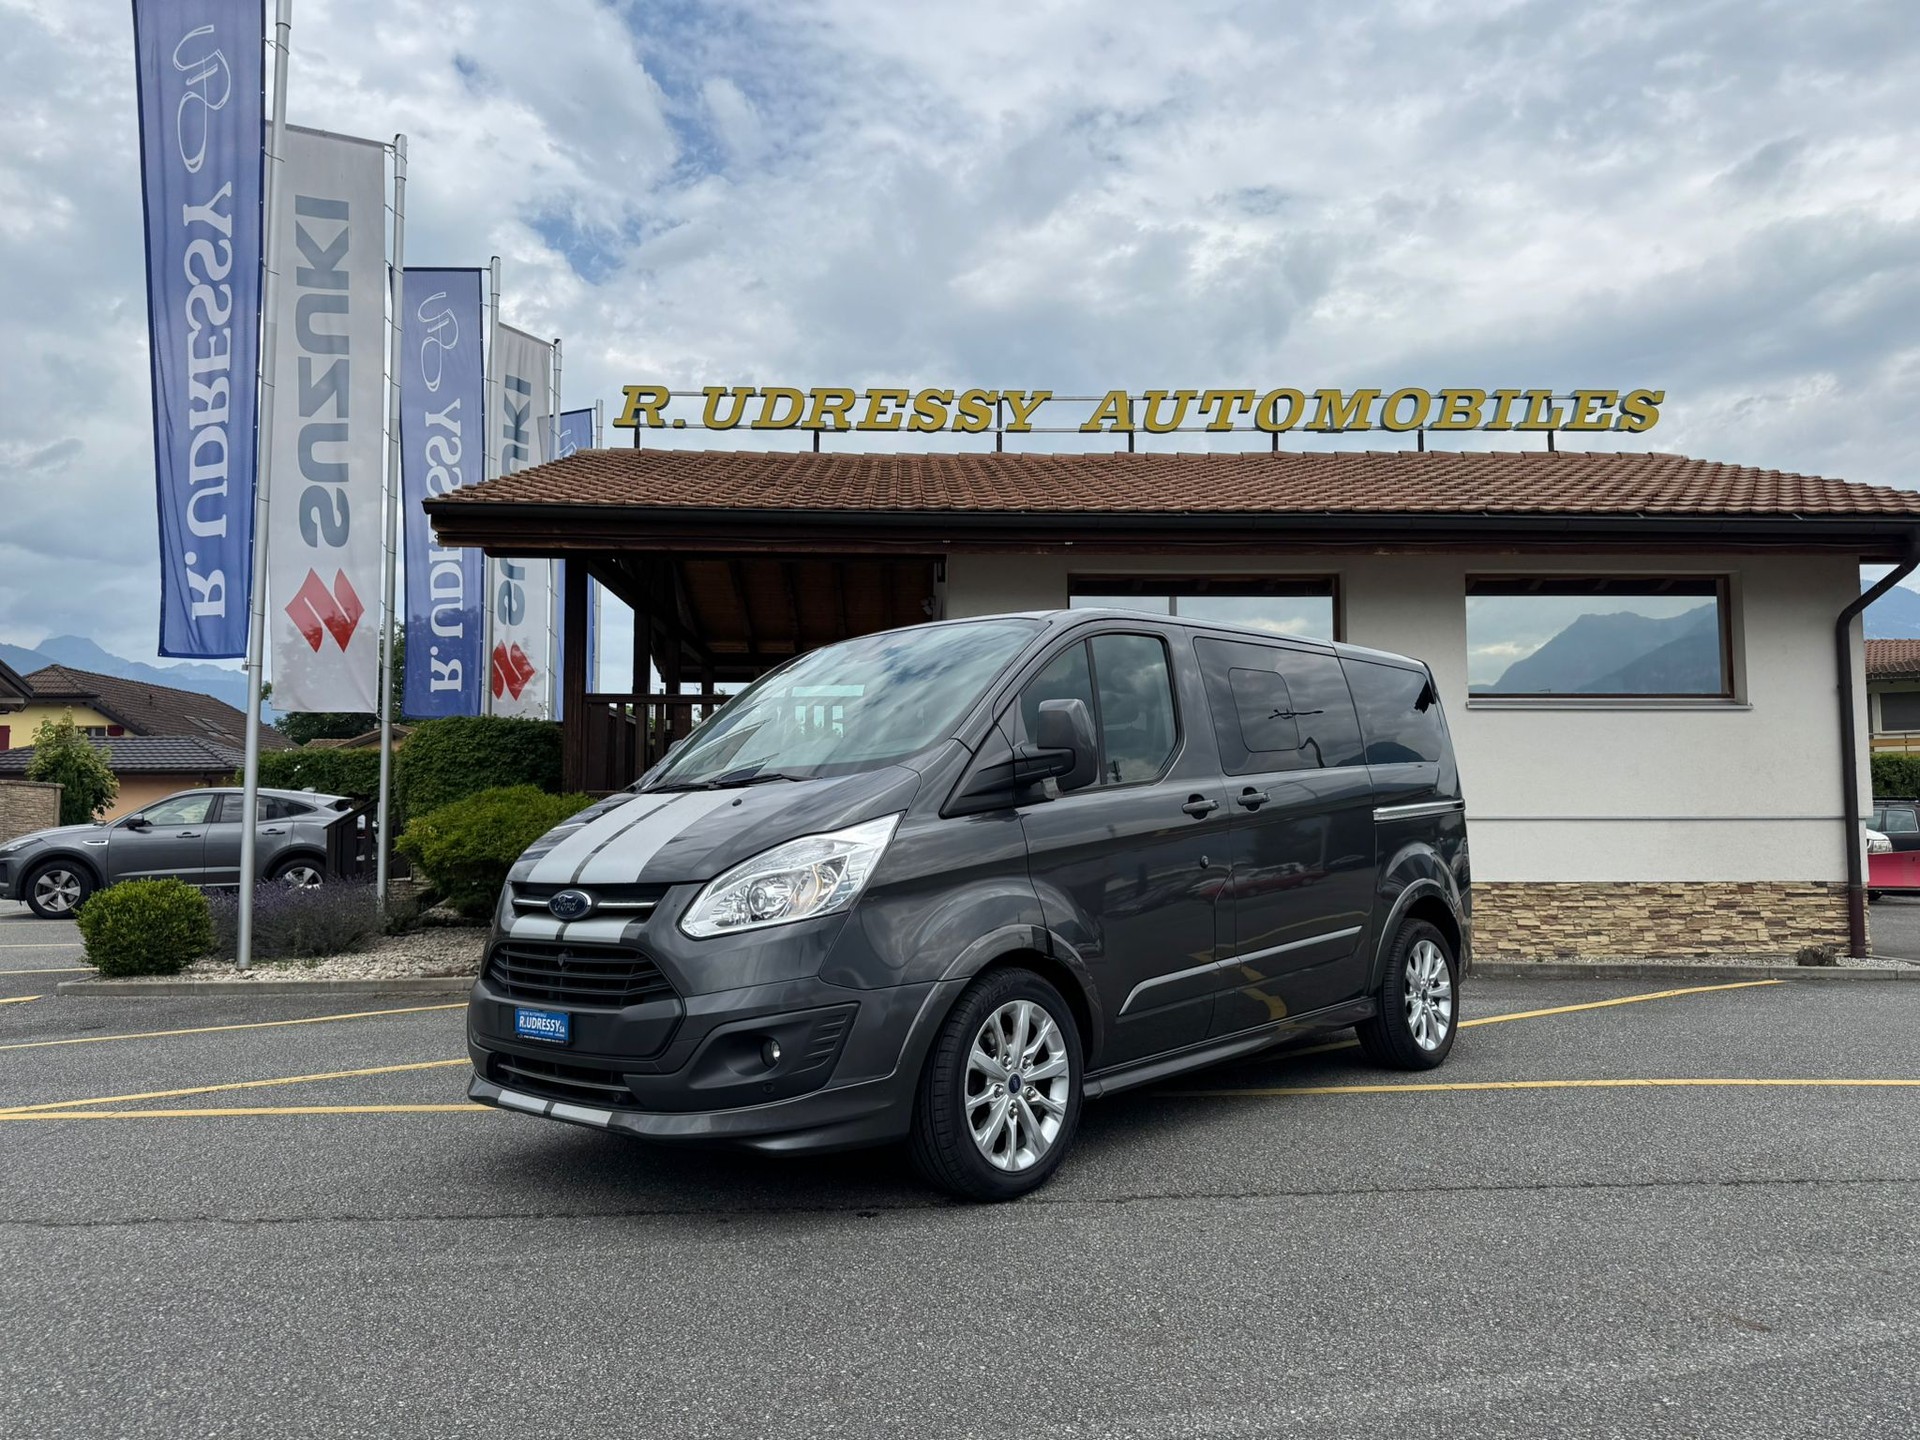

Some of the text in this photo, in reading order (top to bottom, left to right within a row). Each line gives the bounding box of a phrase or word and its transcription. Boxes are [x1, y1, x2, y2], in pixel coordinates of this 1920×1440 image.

[612, 385, 1666, 434] R. UDRESSY AUTOMOBILES
[554, 894, 579, 911] Ford
